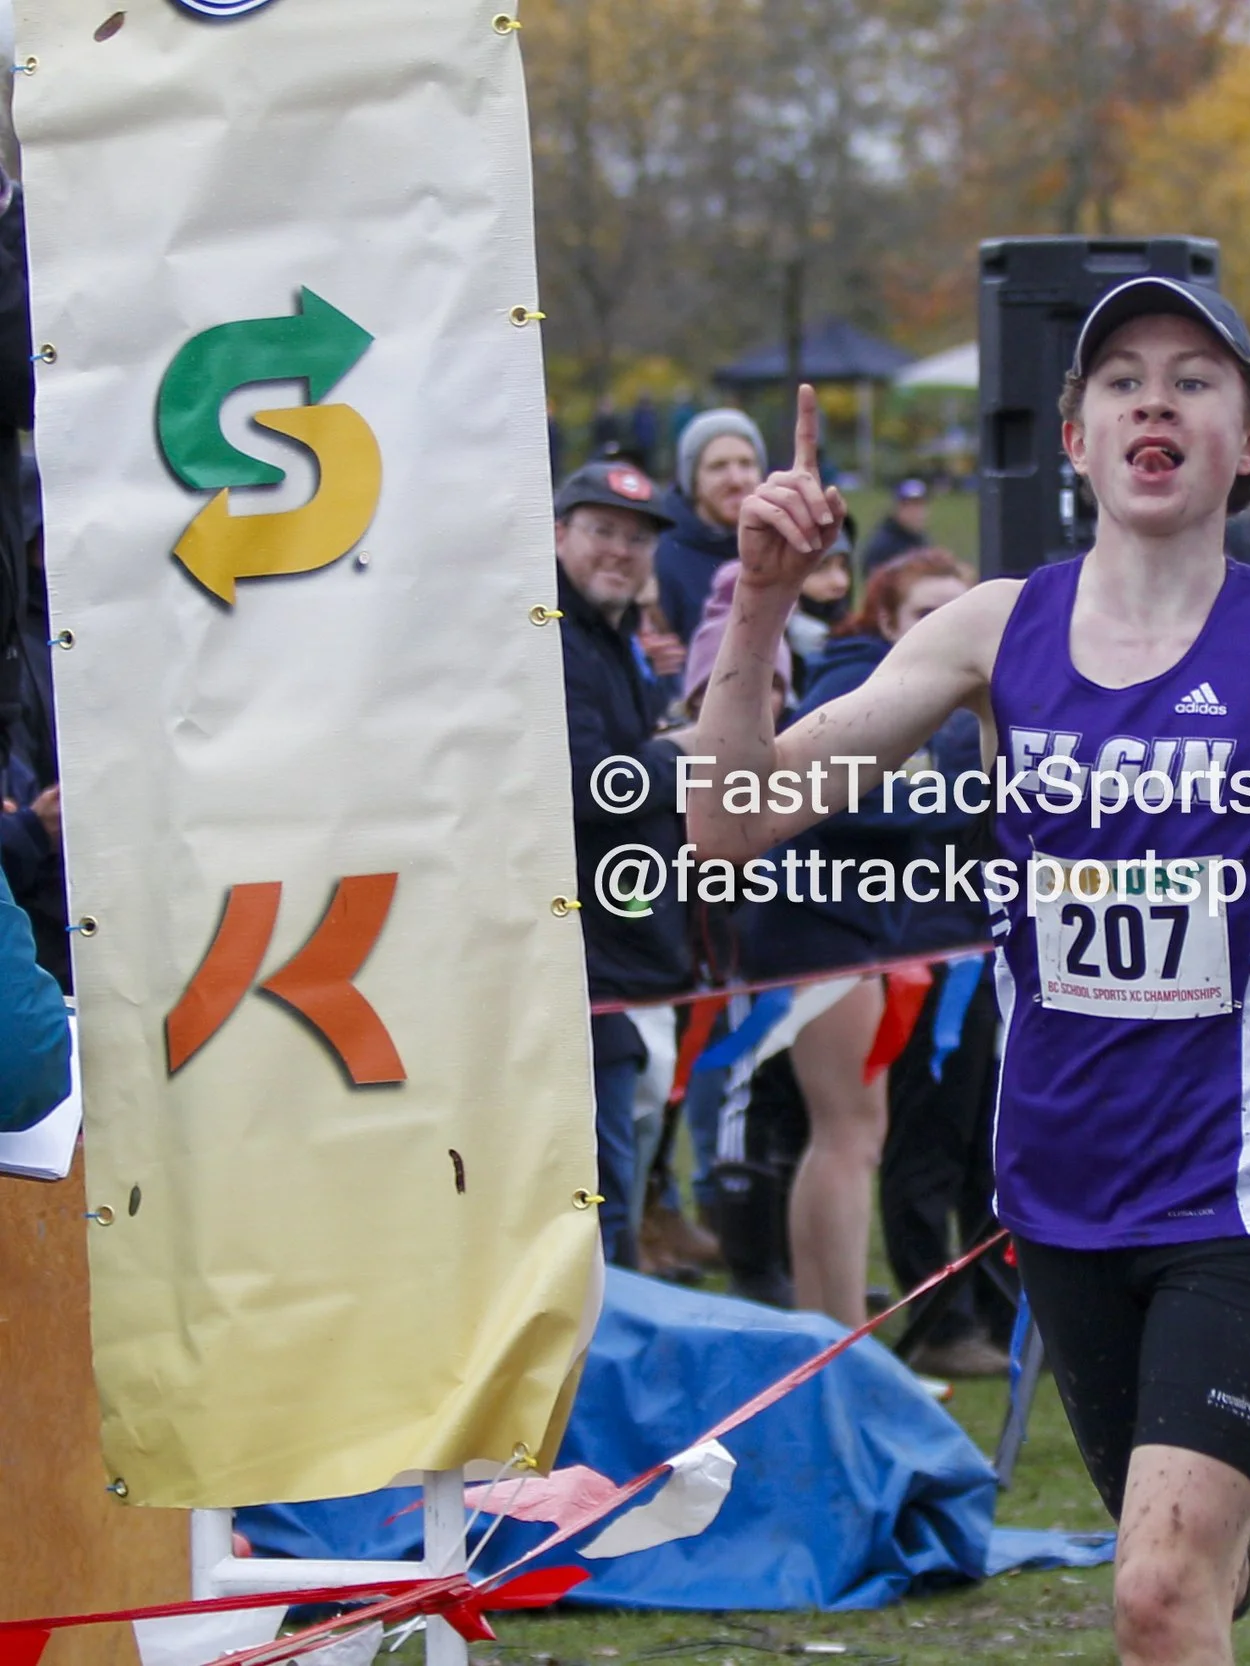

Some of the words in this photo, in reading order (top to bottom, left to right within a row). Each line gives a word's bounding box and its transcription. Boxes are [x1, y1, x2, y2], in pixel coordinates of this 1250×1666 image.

[1174, 701, 1228, 716] adidas
[1009, 725, 1237, 805] ELGIN
[1045, 863, 1206, 896] UBWAY
[1061, 903, 1190, 981] 207
[1047, 981, 1060, 993] BC
[1061, 982, 1091, 999] SCHOOL
[1093, 988, 1127, 1001] SPORTS
[1129, 989, 1143, 1002] XC
[1144, 987, 1222, 1002] CHAMPIONSHIPS
